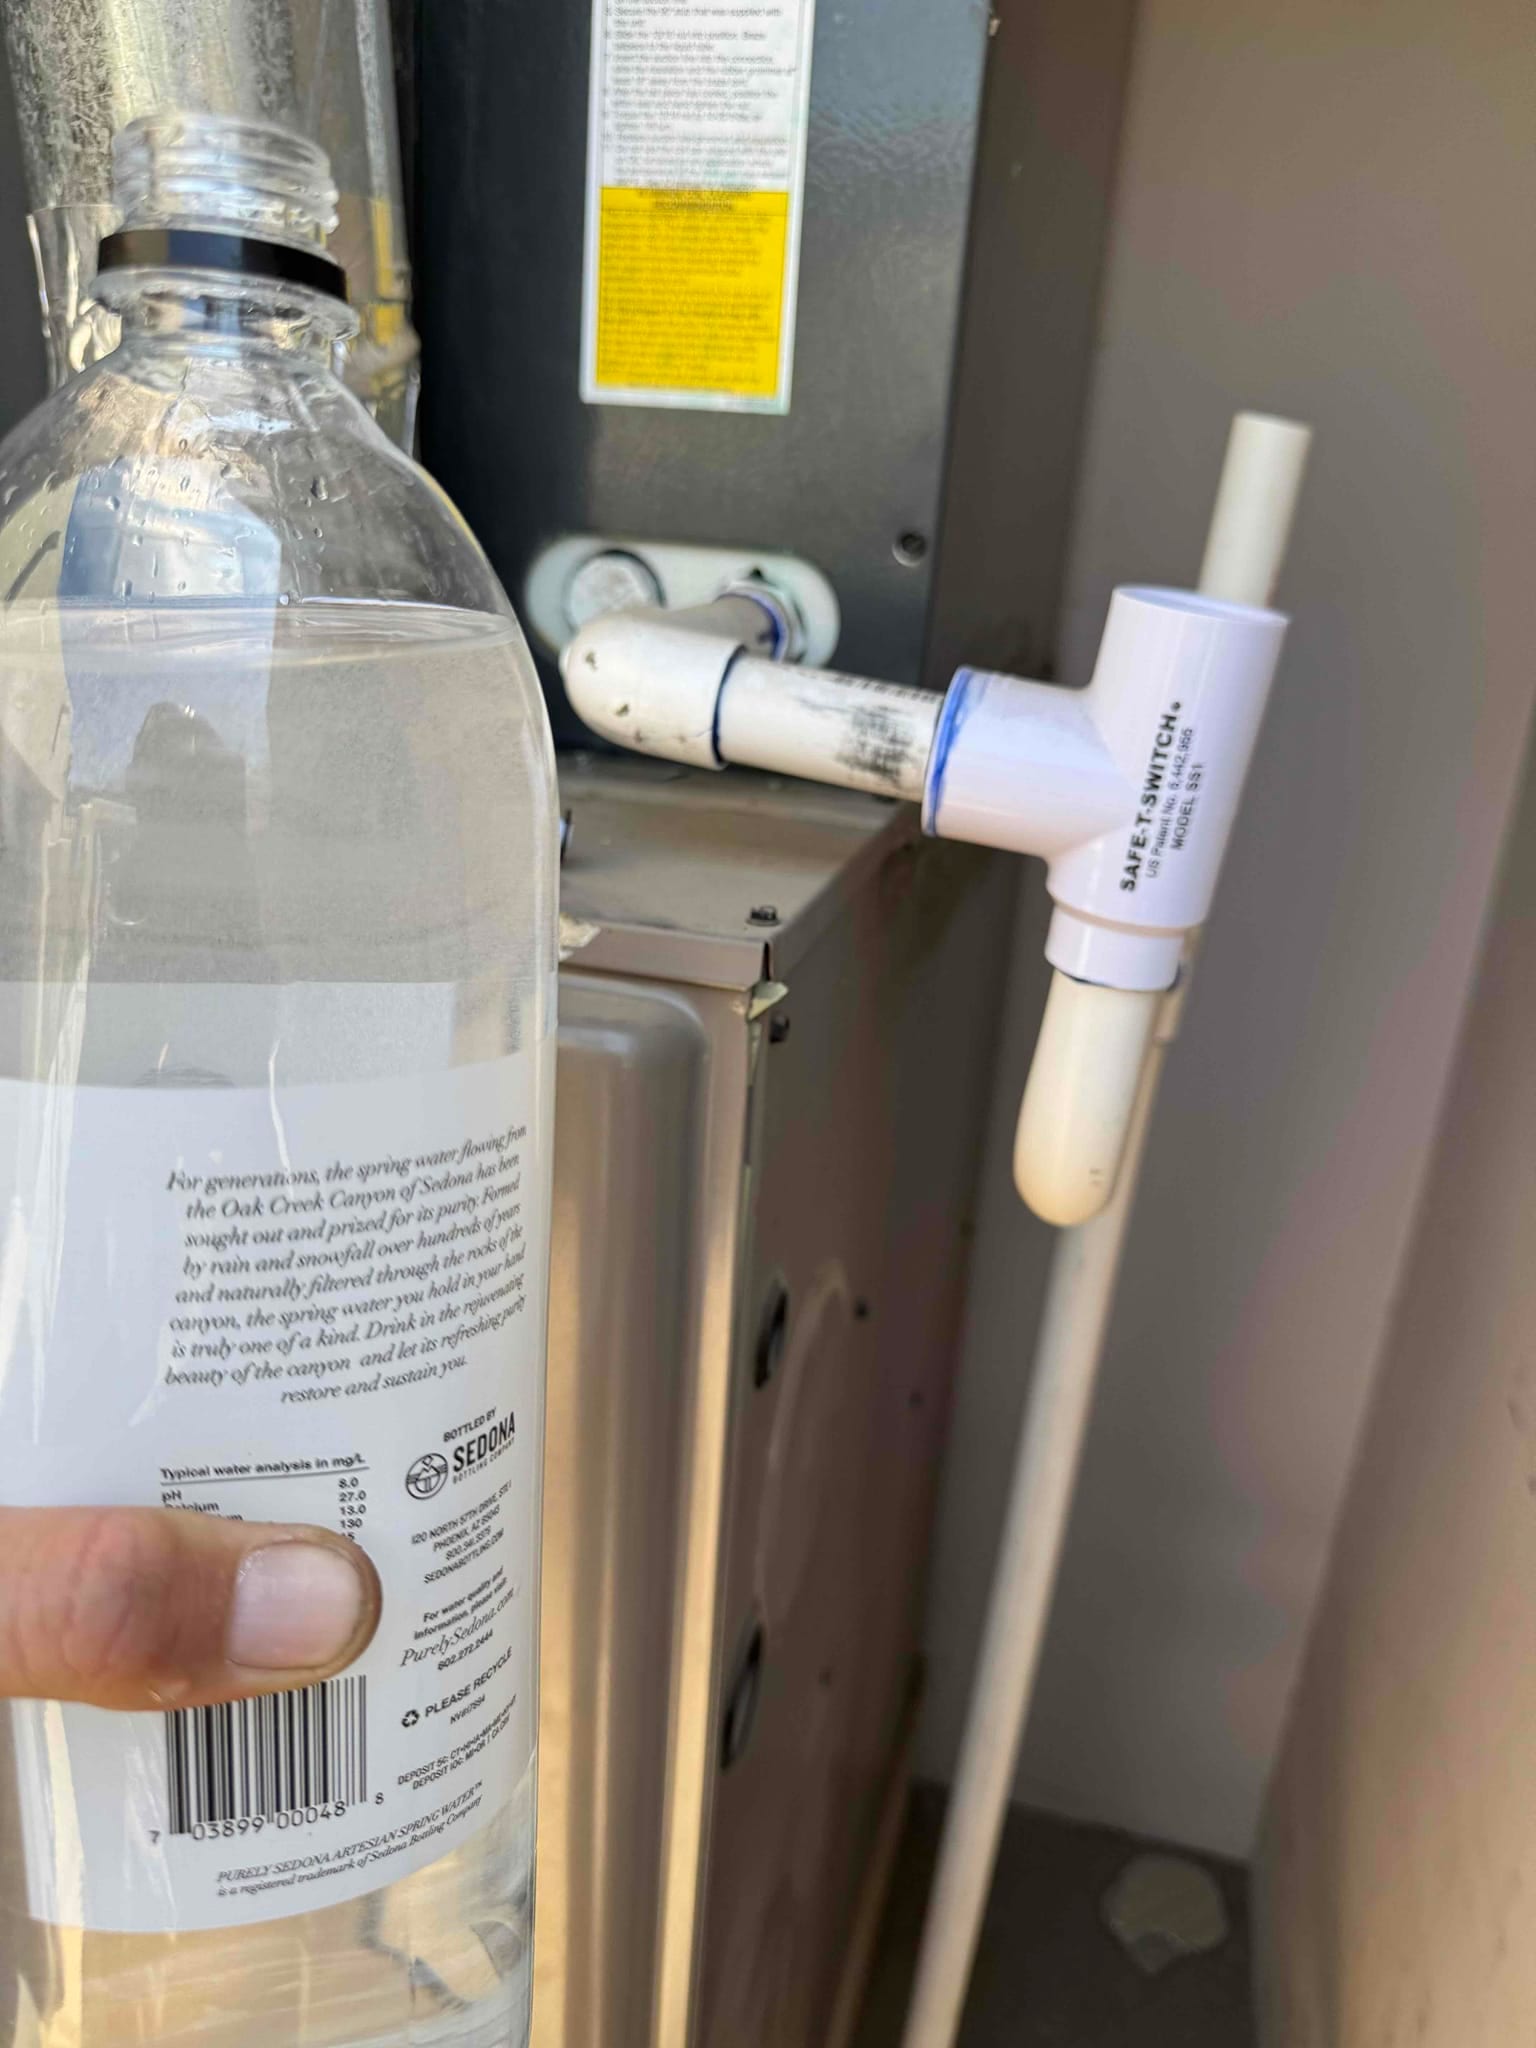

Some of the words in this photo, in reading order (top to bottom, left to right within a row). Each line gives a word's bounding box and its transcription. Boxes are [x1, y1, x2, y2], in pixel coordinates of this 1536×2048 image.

[1150, 817, 1170, 857] Patent
[1169, 796, 1195, 851] MODEL
[1145, 859, 1160, 879] US
[166, 1170, 203, 1192] For
[204, 1169, 320, 1196] generations,
[325, 1160, 353, 1182] the
[357, 1153, 411, 1183] spring
[415, 1150, 460, 1168] water
[457, 1133, 505, 1165] flowing
[504, 1124, 527, 1149] from
[186, 1197, 217, 1219] the
[221, 1195, 264, 1218] Oak
[270, 1190, 325, 1215] Creek
[329, 1188, 396, 1210] Canyon
[399, 1176, 420, 1203] of
[418, 1170, 474, 1194] Sedona
[476, 1162, 498, 1182] has
[498, 1153, 520, 1173] been
[184, 1224, 249, 1253] sought
[252, 1227, 284, 1245] out
[287, 1218, 326, 1241] and
[326, 1210, 387, 1244] prized
[384, 1208, 414, 1234] for
[417, 1204, 435, 1223] its
[435, 1194, 480, 1224] purity.
[482, 1171, 521, 1205] Formed
[175, 1283, 215, 1303] and
[218, 1277, 306, 1302] naturally
[304, 1266, 375, 1299] filtered
[376, 1254, 440, 1280] through
[443, 1249, 464, 1269] the
[467, 1237, 498, 1261] rocks
[499, 1226, 514, 1251] of
[510, 1224, 524, 1242] the
[183, 1255, 207, 1280] by
[210, 1254, 250, 1275] rain
[255, 1249, 295, 1271] and
[297, 1240, 376, 1267] snowfall
[377, 1240, 414, 1257] over
[416, 1215, 482, 1250] hundreds
[483, 1208, 500, 1232] of
[495, 1202, 521, 1229] years
[169, 1314, 241, 1335] canyon,
[246, 1307, 276, 1328] the
[278, 1303, 339, 1329] spring
[341, 1297, 393, 1316] water
[393, 1290, 425, 1312] you
[428, 1273, 461, 1299] hold
[462, 1272, 475, 1290] in
[476, 1263, 504, 1288] your
[504, 1242, 527, 1270] hand
[171, 1339, 187, 1358] is
[190, 1336, 236, 1360] truly
[238, 1339, 273, 1355] one
[276, 1332, 302, 1356] of
[299, 1336, 312, 1349] a
[316, 1324, 360, 1346] kind.
[364, 1313, 417, 1340] Drink
[420, 1310, 436, 1328] in
[439, 1303, 460, 1323] the
[463, 1273, 525, 1315] rejuvenating
[165, 1366, 229, 1387] beauty
[231, 1361, 256, 1385] of
[253, 1361, 283, 1379] the
[287, 1358, 351, 1379] canyon
[360, 1342, 396, 1367] and
[397, 1341, 418, 1359] let
[420, 1337, 438, 1354] its
[441, 1313, 502, 1349] refreshing
[281, 1385, 342, 1403] restore
[345, 1372, 381, 1396] and
[382, 1362, 438, 1389] sustain
[438, 1355, 468, 1378] you.
[443, 1415, 485, 1442] BOTTLED
[486, 1406, 497, 1421] BY
[453, 1411, 515, 1472] SEDONA
[160, 1465, 210, 1480] Typical
[213, 1463, 251, 1475] water
[255, 1459, 312, 1472] analysis
[315, 1457, 329, 1468] in
[161, 1489, 182, 1503] pH
[338, 1476, 359, 1489] 8.0
[339, 1490, 367, 1502] 27.0
[453, 1458, 488, 1484] BOTTLING
[340, 1504, 367, 1515] 13.0
[340, 1518, 363, 1529] 130
[423, 1611, 440, 1623] For
[441, 1597, 466, 1615] water
[467, 1578, 491, 1601] quality
[492, 1565, 503, 1582] and
[470, 1591, 493, 1614] please
[400, 1587, 514, 1667] PurelySedona.com
[425, 1684, 471, 1717] PLEASE
[473, 1646, 512, 1690] RECYCLE
[397, 1760, 436, 1785] DEPOSIT
[412, 1766, 448, 1790] DEPOSIT
[192, 1815, 265, 1841] 03899
[276, 1800, 346, 1829] 00048
[217, 1886, 228, 1897] is
[229, 1887, 238, 1895] a
[240, 1874, 296, 1895] registered
[297, 1858, 356, 1883] trademark
[357, 1853, 370, 1868] of
[368, 1843, 407, 1863] Sedona
[410, 1821, 446, 1847] Bottling
[446, 1794, 483, 1825] Company
[217, 1864, 272, 1883] PURELY
[272, 1852, 331, 1875] SEDONA
[331, 1828, 398, 1860] ARTESIAN
[398, 1809, 440, 1838] SPRING
